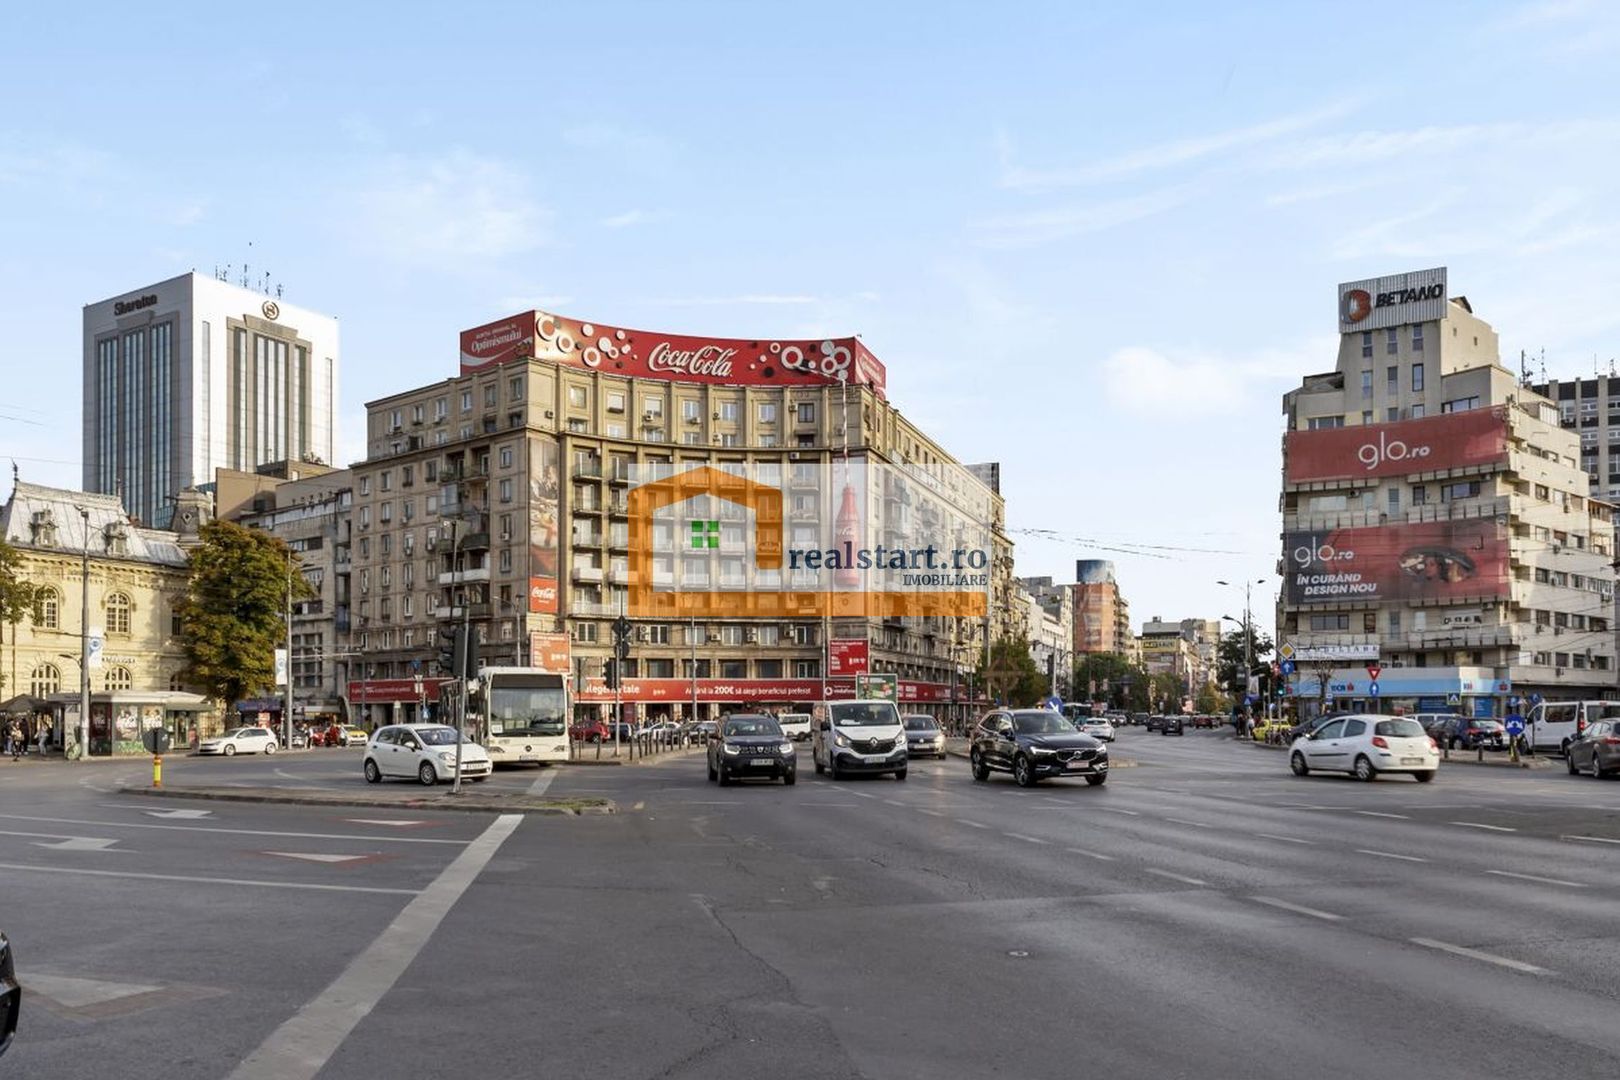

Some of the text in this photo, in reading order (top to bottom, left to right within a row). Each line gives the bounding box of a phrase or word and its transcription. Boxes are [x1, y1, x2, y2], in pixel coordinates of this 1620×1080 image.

[1375, 283, 1444, 308] BETANO
[1358, 431, 1431, 470] glo.ro
[1294, 536, 1354, 568] glo.ro
[1296, 571, 1362, 586] ÎN CURÂND
[1304, 582, 1377, 596] DESIGN NOU
[714, 686, 735, 695] 200€
